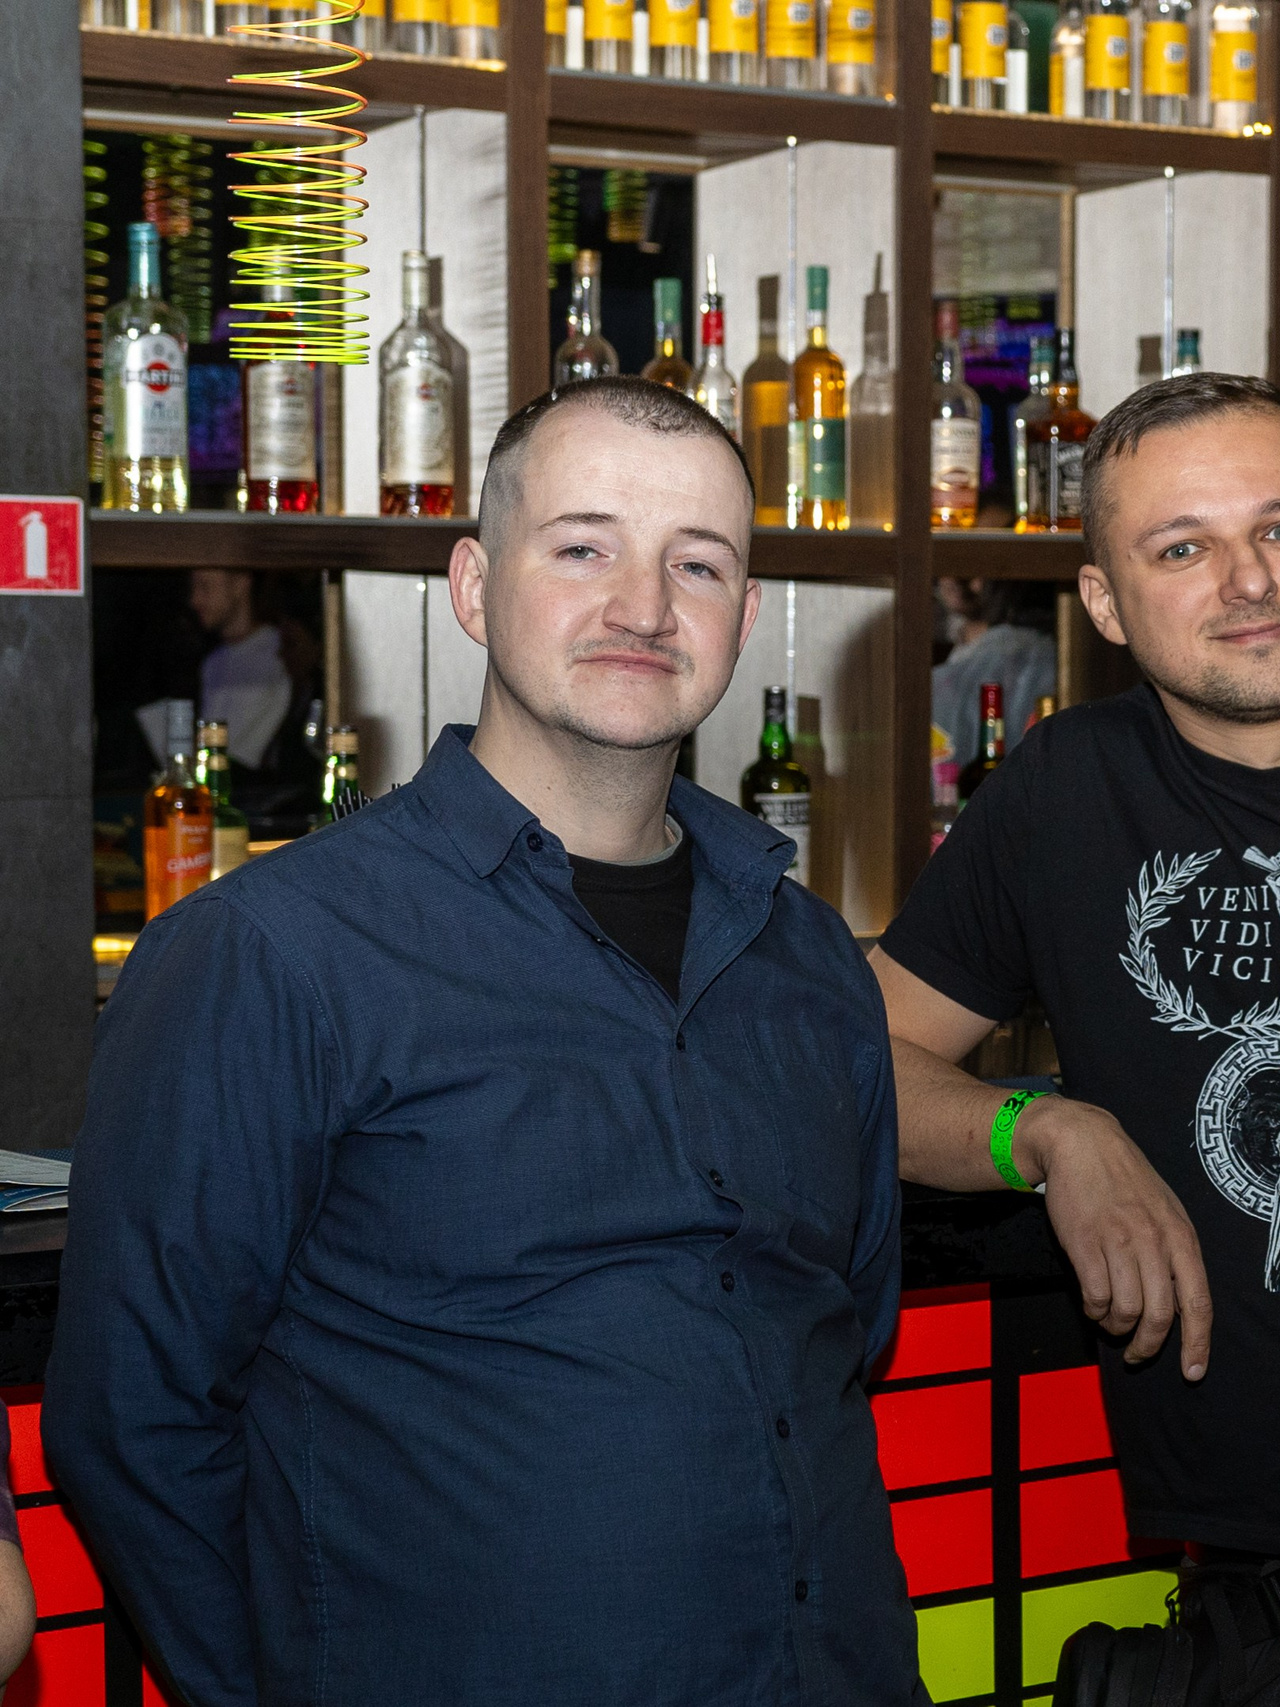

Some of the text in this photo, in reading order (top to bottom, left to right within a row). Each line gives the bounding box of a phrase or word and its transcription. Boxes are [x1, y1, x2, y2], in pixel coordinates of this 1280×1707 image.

[1198, 885, 1270, 912] VENI
[1190, 919, 1271, 947] VIDI
[1182, 947, 1272, 983] VICI
